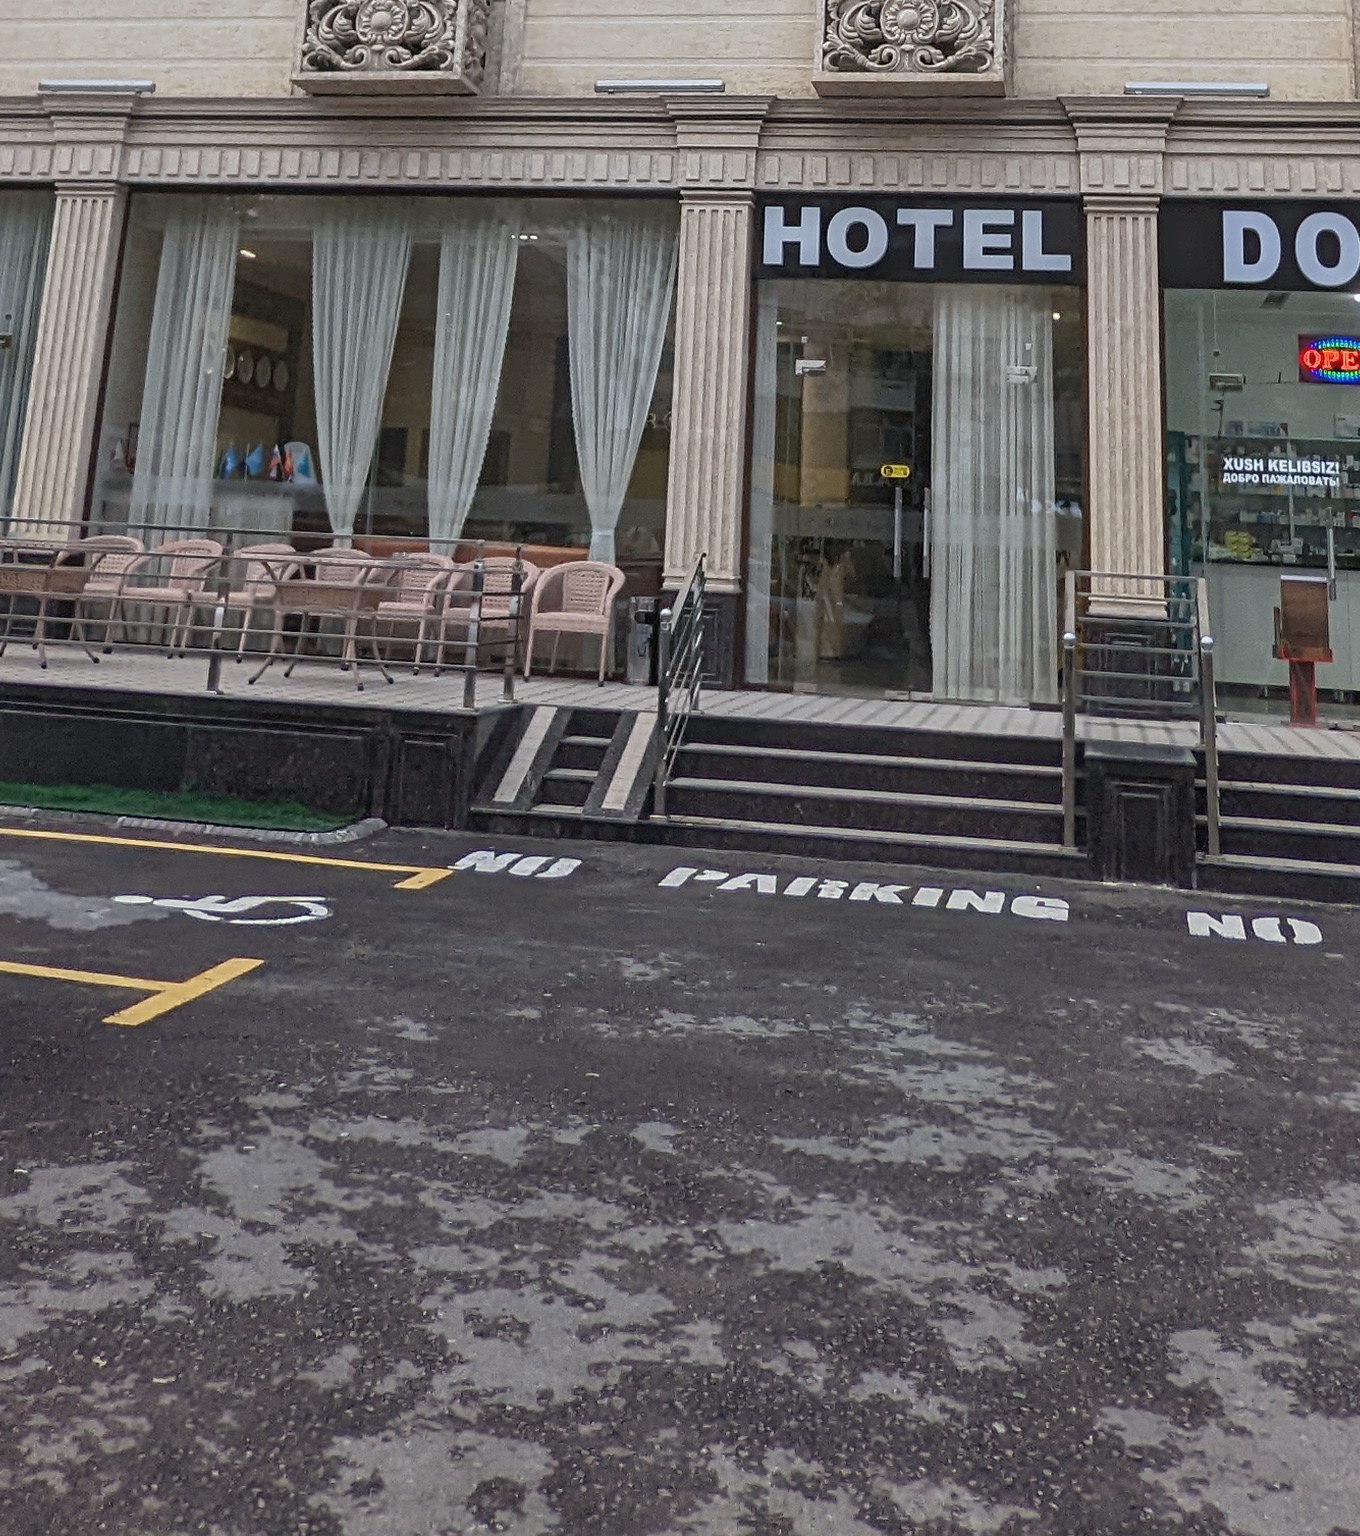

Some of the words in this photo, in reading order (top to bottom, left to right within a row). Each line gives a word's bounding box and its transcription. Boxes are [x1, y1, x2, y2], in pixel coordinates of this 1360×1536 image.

[762, 205, 1072, 272] HOTEL
[1223, 457, 1264, 472] XUSH
[1268, 459, 1340, 474] KELIBSIZ!
[1223, 473, 1260, 484] ДОБРО
[450, 850, 584, 880] NO
[658, 866, 1070, 922] PARKING
[1187, 910, 1323, 945] NO
